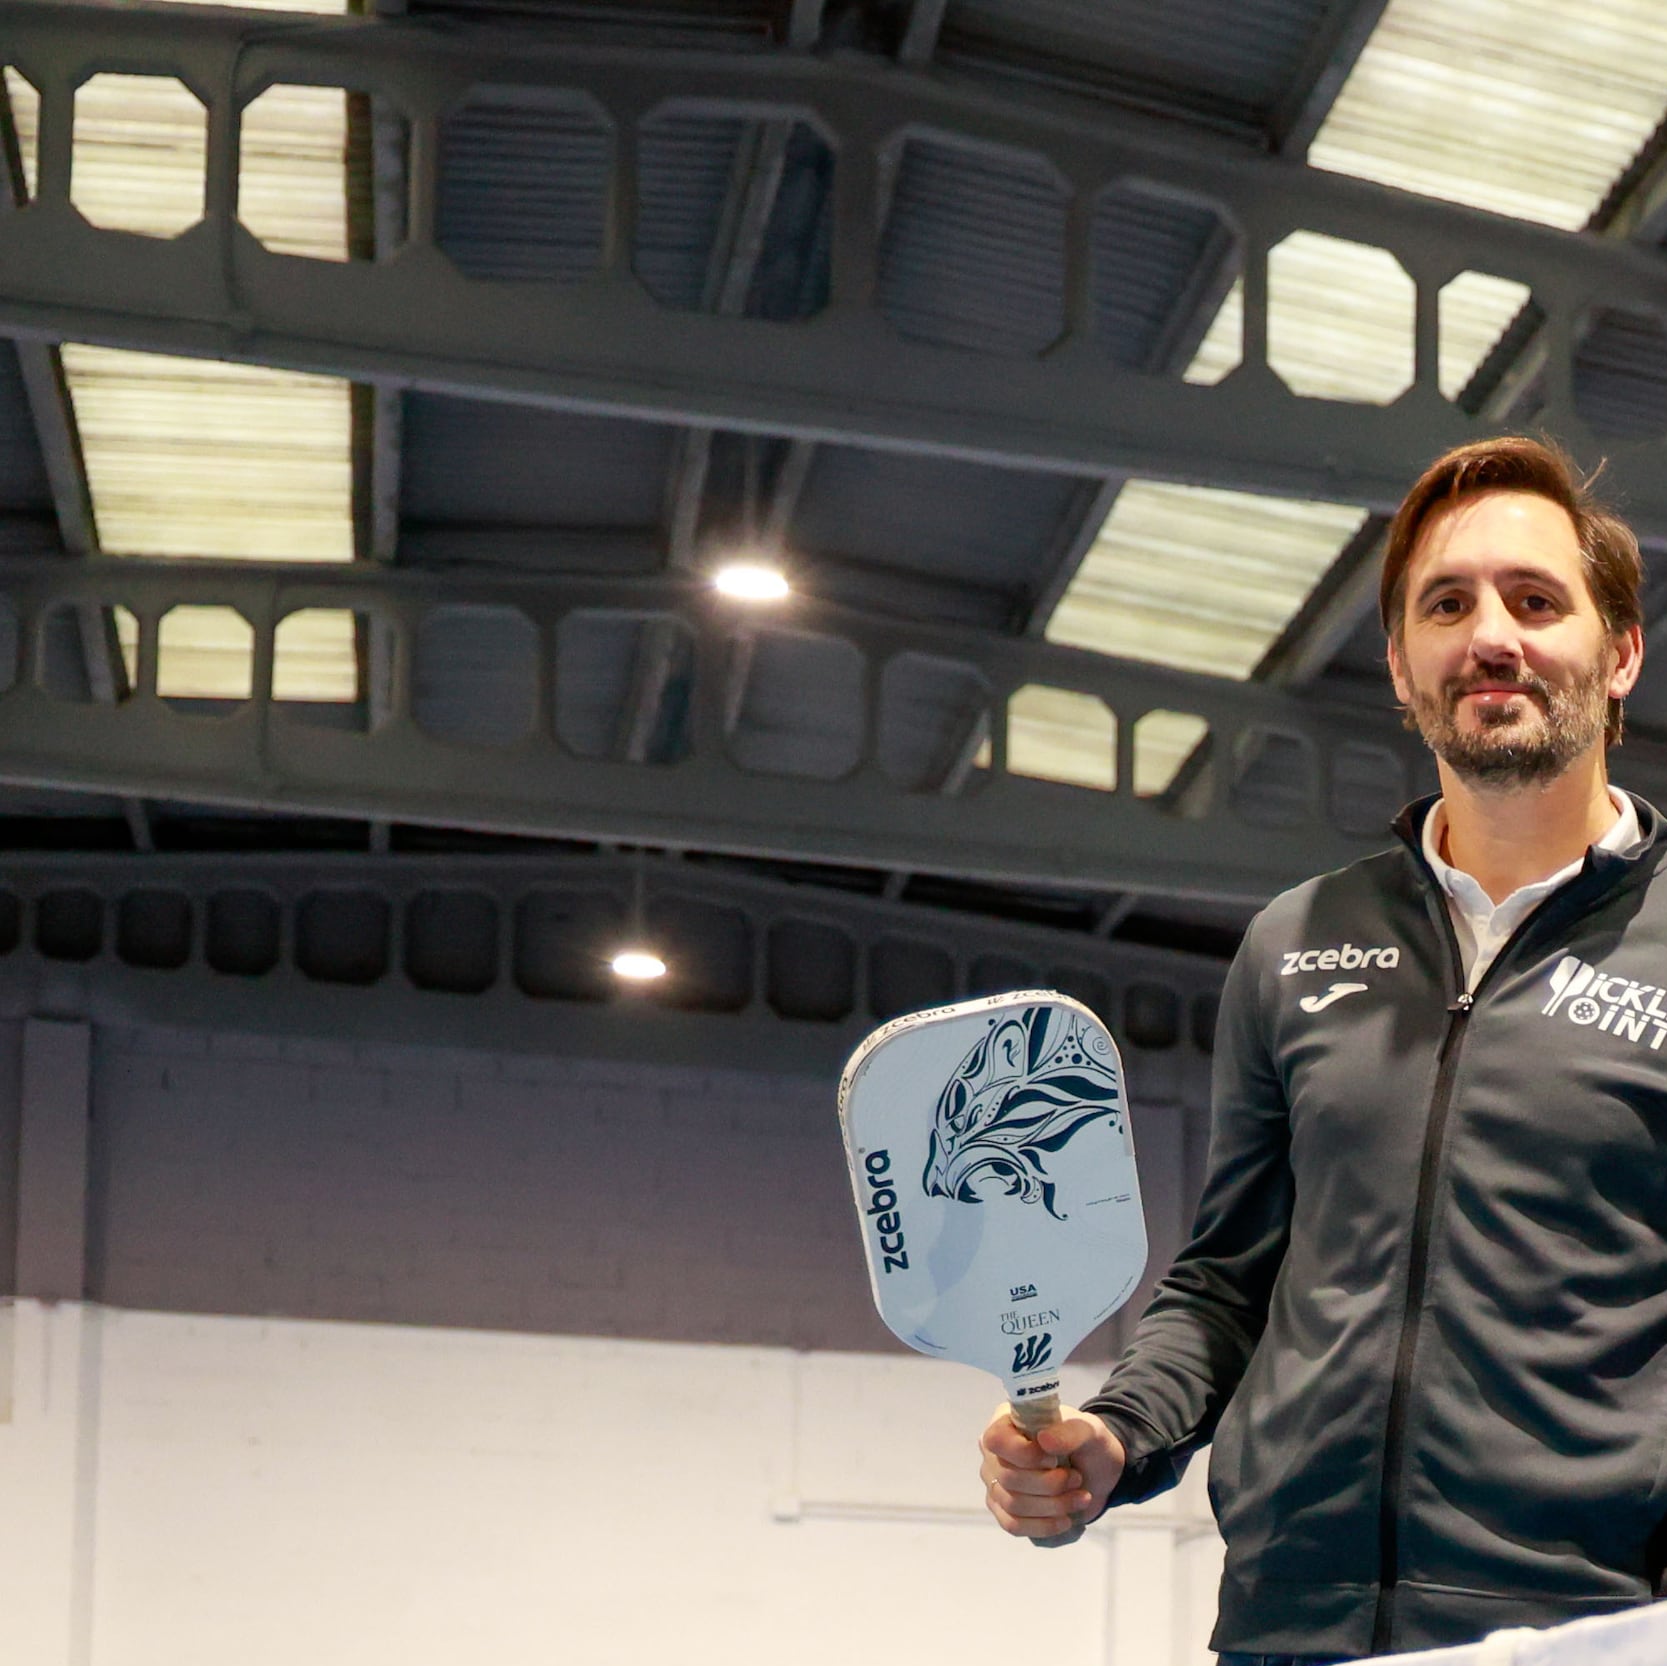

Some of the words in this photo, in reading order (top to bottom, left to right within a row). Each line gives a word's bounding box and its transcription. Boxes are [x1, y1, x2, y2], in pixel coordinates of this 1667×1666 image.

[1281, 943, 1400, 976] zcebra
[865, 1149, 909, 1274] zcebra
[1010, 1284, 1037, 1297] USA
[1001, 1310, 1018, 1322] THE
[1001, 1307, 1061, 1336] QUEEN
